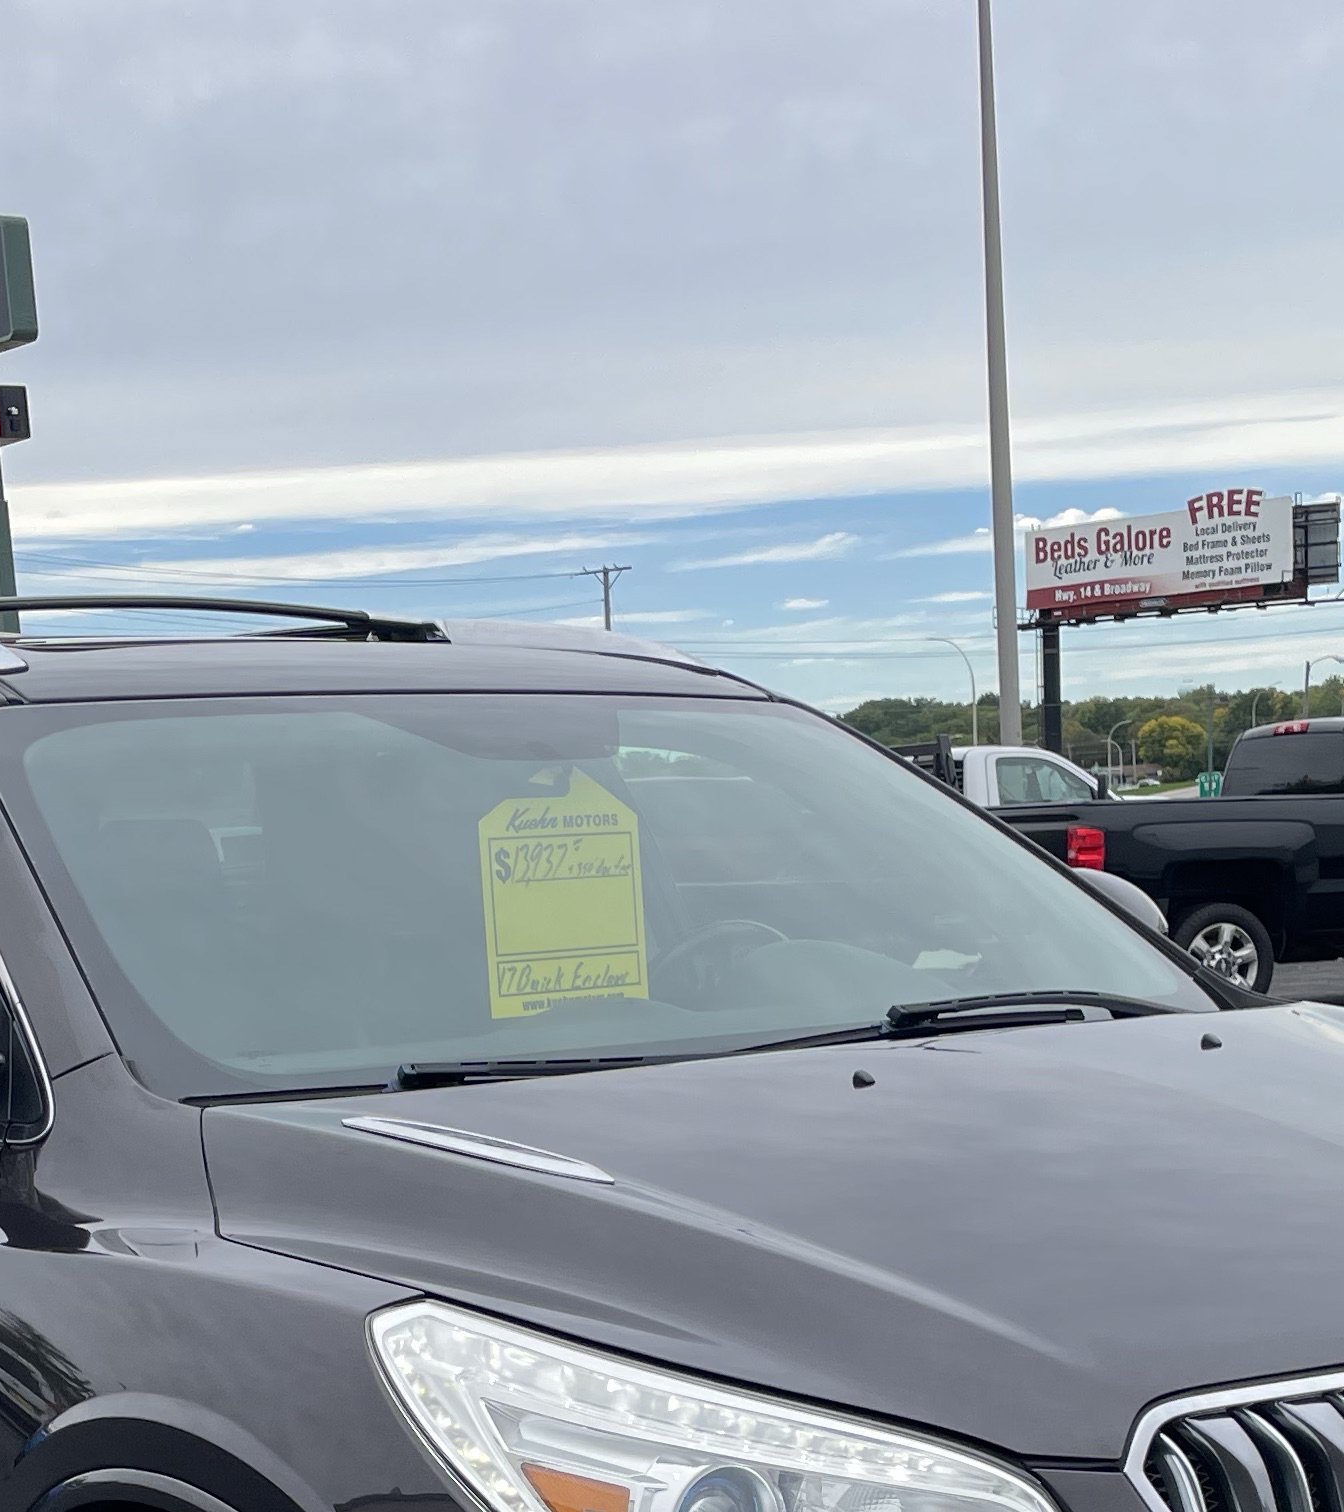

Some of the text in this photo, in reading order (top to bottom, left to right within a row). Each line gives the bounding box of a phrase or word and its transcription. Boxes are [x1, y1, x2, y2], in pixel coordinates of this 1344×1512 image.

[1187, 489, 1264, 526] FREE
[1195, 521, 1257, 537] Local Delivery
[1034, 524, 1172, 565] Beds Galore
[1183, 533, 1271, 553] Bed Frame & Sheets
[1052, 550, 1155, 580] Leather & More
[1186, 548, 1268, 566] Mattress Protector
[1182, 562, 1273, 580] Memory Foam Pillow
[1055, 588, 1077, 603] Hwy.
[1080, 585, 1092, 599] 14
[1104, 581, 1152, 596] Broadway
[505, 806, 619, 833] Kuehn MOTORS
